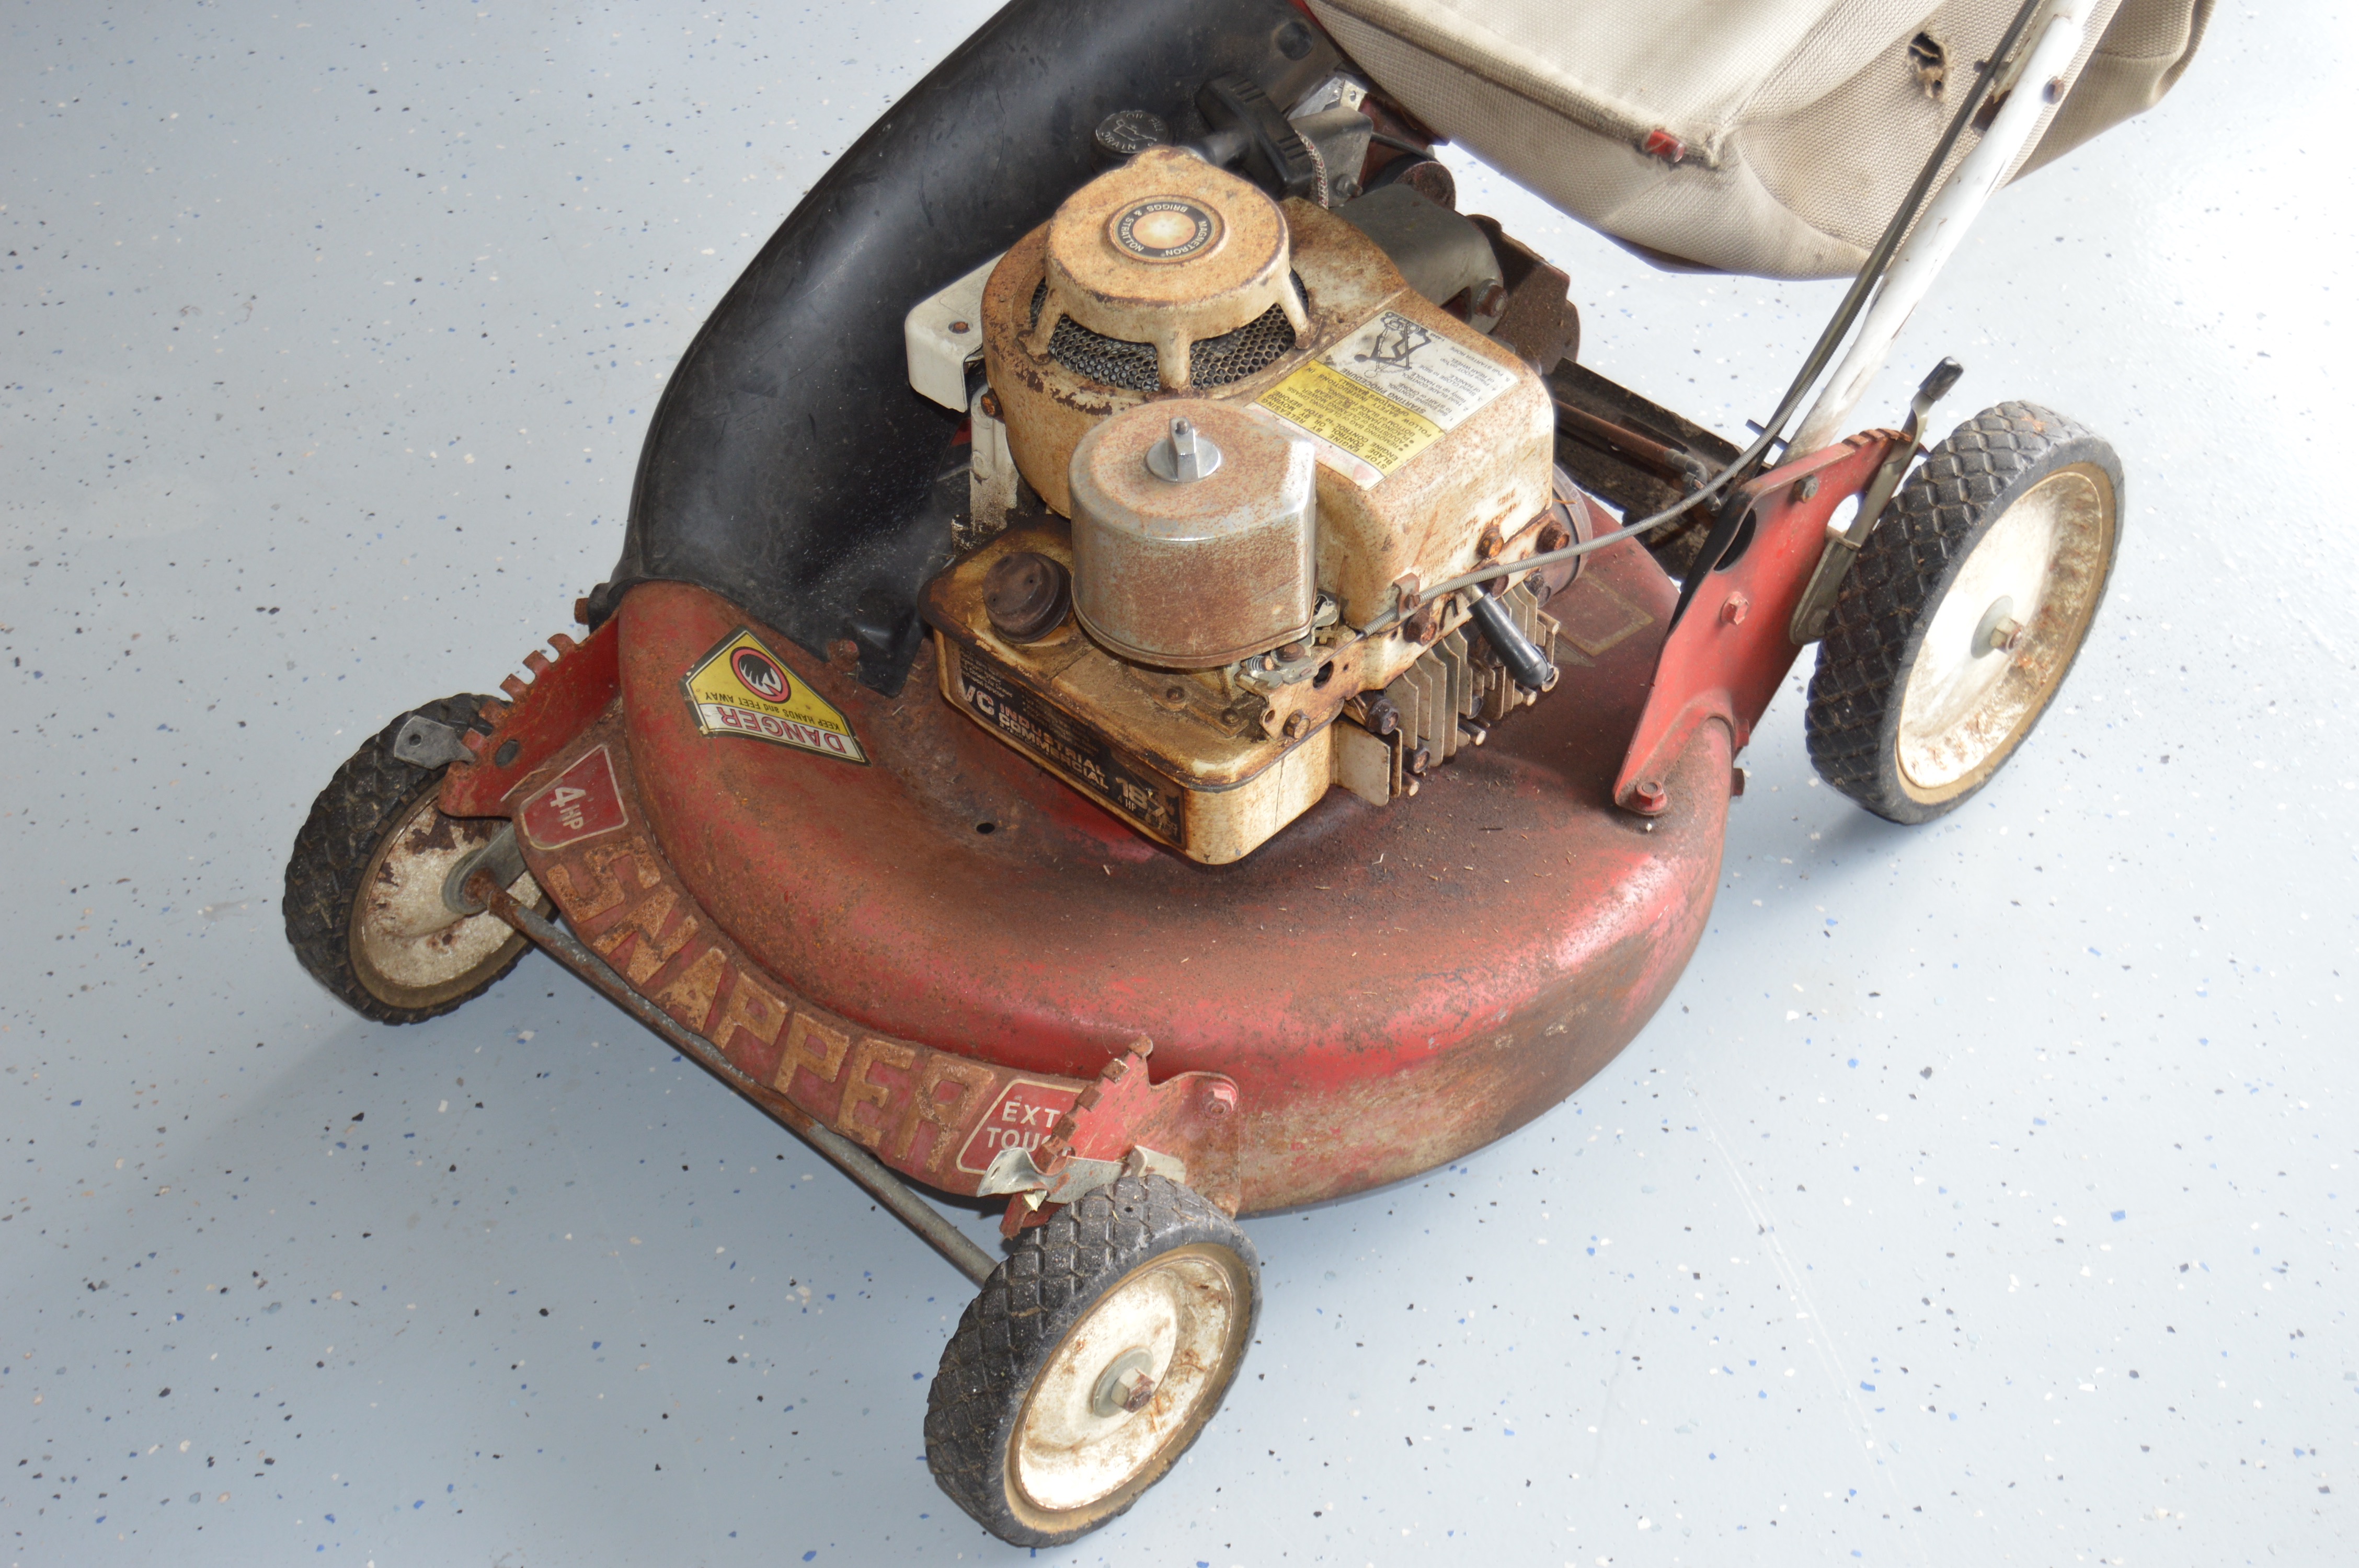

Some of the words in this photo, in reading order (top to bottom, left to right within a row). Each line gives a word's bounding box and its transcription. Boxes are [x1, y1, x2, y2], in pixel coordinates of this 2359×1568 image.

[1121, 217, 1144, 252] STRATTON
[1449, 346, 1467, 356] ROPE
[1417, 364, 1433, 373] SIDE
[1465, 354, 1492, 370] STARTER
[1457, 367, 1474, 377] FOOT
[1470, 368, 1487, 378] REAR
[1491, 368, 1504, 376] Pull
[1318, 374, 1368, 401] INSTRUCTIONS
[1339, 368, 1388, 394] PROCEDURE
[1401, 373, 1428, 388] CONTROL
[1438, 375, 1460, 386] CLOSE
[1473, 375, 1491, 386] Place
[1313, 388, 1334, 399] NEAR
[1386, 383, 1415, 398] CONTROL
[1427, 386, 1448, 398] BLADE
[1449, 392, 1467, 402] firmly
[1458, 385, 1476, 396] Stand
[1266, 394, 1296, 411] MOVING
[1309, 399, 1342, 418] CLEARING
[1368, 394, 1410, 417] OPERATOR'S
[1371, 402, 1399, 417] SAFETY
[1386, 392, 1426, 413] STARTING
[1413, 397, 1437, 410] ENGINE
[1425, 397, 1446, 409] START
[1447, 397, 1462, 406] Hold
[1260, 398, 1306, 423] RELEASING
[1303, 407, 1324, 419] STOP
[1326, 402, 1361, 420] CLEANING
[1357, 405, 1380, 417] BLADE
[1357, 411, 1381, 424] HANDS
[1348, 420, 1364, 429] BAG
[1380, 423, 1410, 441] PLACING
[1387, 420, 1416, 437] BOTTOM
[1401, 418, 1432, 437] FOLLOW
[1329, 428, 1365, 447] CONTROL
[1333, 423, 1369, 443] CONTROL
[1363, 428, 1399, 448] REMOVING
[1367, 423, 1405, 444] ADJUSTING
[1326, 433, 1360, 452] ENGINE
[1367, 448, 1393, 465] BLADE
[1369, 442, 1399, 460] ENGINE
[1364, 453, 1388, 469] STOP
[705, 691, 734, 702] AWAY
[738, 697, 760, 709] FEET
[763, 704, 779, 713] and
[783, 709, 814, 724] HANDS
[716, 707, 846, 754] DANGER
[818, 716, 839, 731] KEEP
[1000, 703, 1105, 777] INDUSTRIAL
[999, 712, 1109, 790] COMMERCIAL
[550, 787, 586, 808] 4
[1116, 777, 1165, 816] 187
[1126, 799, 1137, 811] HP
[560, 804, 583, 829] HP
[546, 836, 995, 1172] SNAPPER
[1002, 1101, 1061, 1128] EXT
